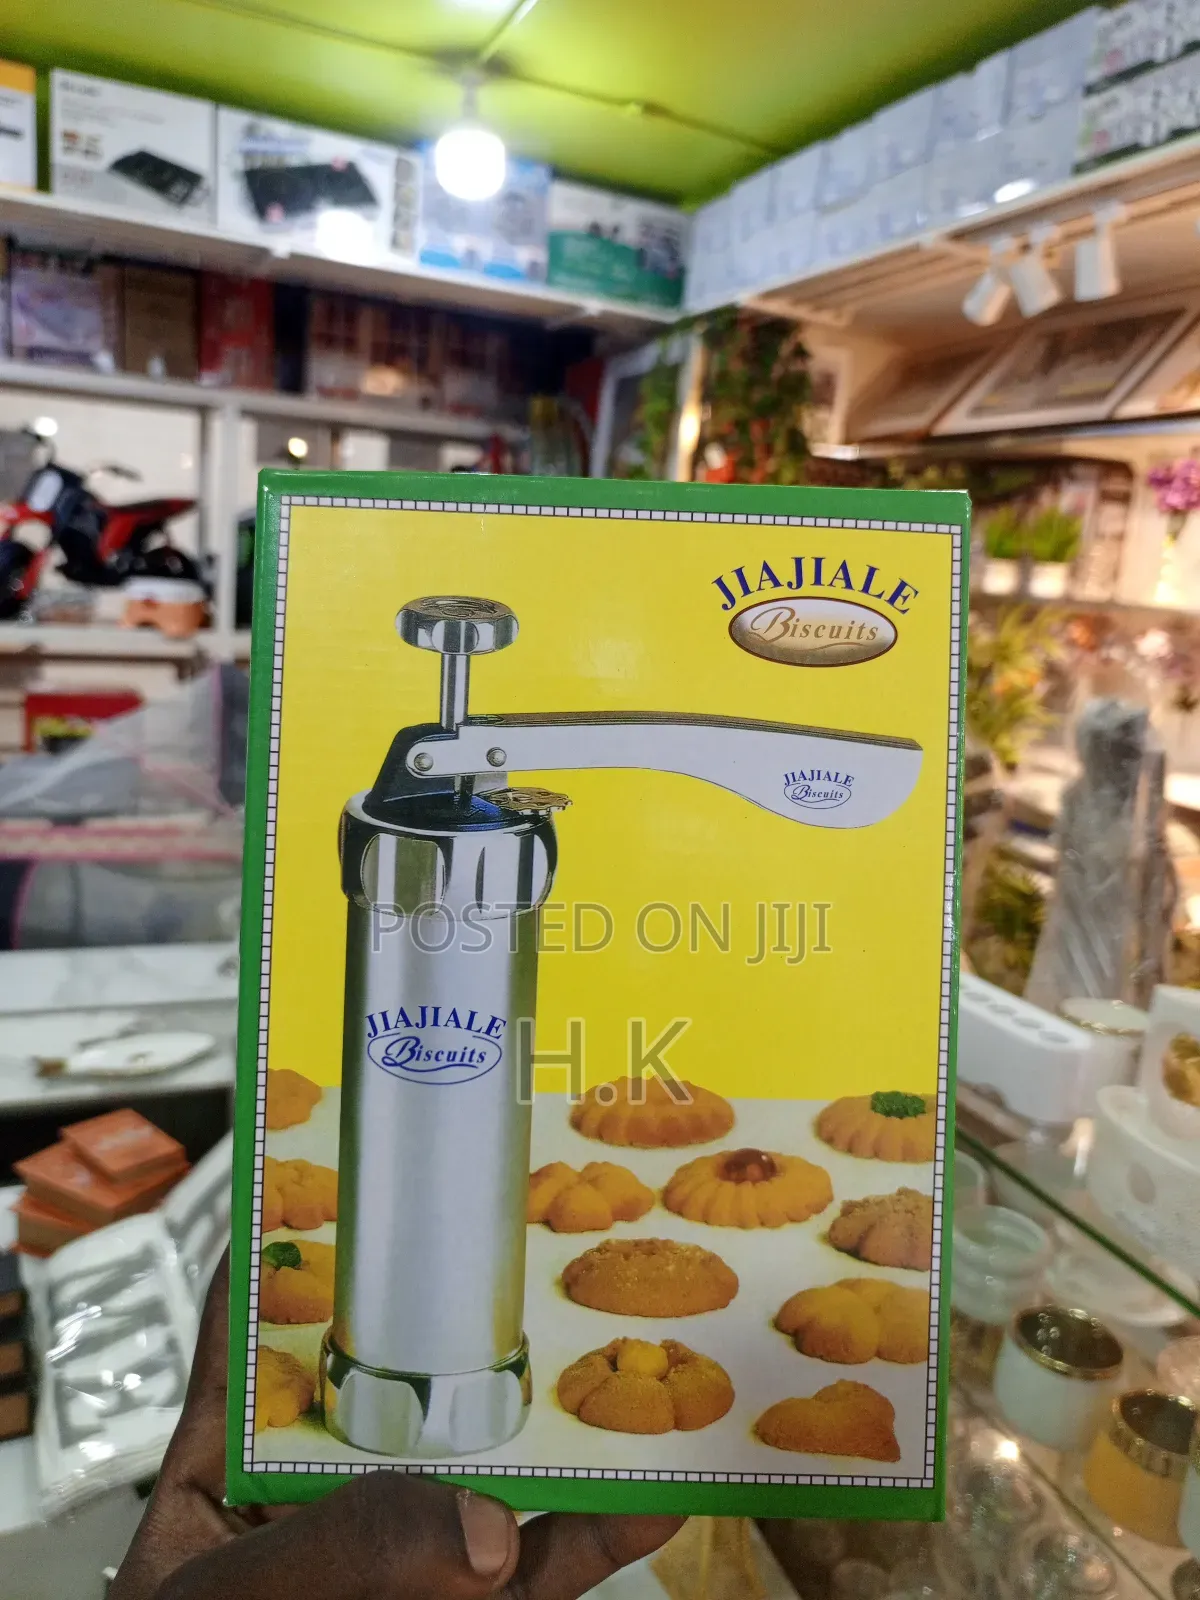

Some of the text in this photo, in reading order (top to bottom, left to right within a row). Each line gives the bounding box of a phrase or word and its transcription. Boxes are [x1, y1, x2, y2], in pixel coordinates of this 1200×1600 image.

[711, 556, 920, 615] JIAJIALE
[750, 606, 879, 645] Biscuits
[783, 769, 855, 787] JIAJIALE
[791, 784, 844, 802] Biscuits
[365, 1005, 507, 1040] JIAJIALE
[381, 1036, 487, 1069] Biscuits
